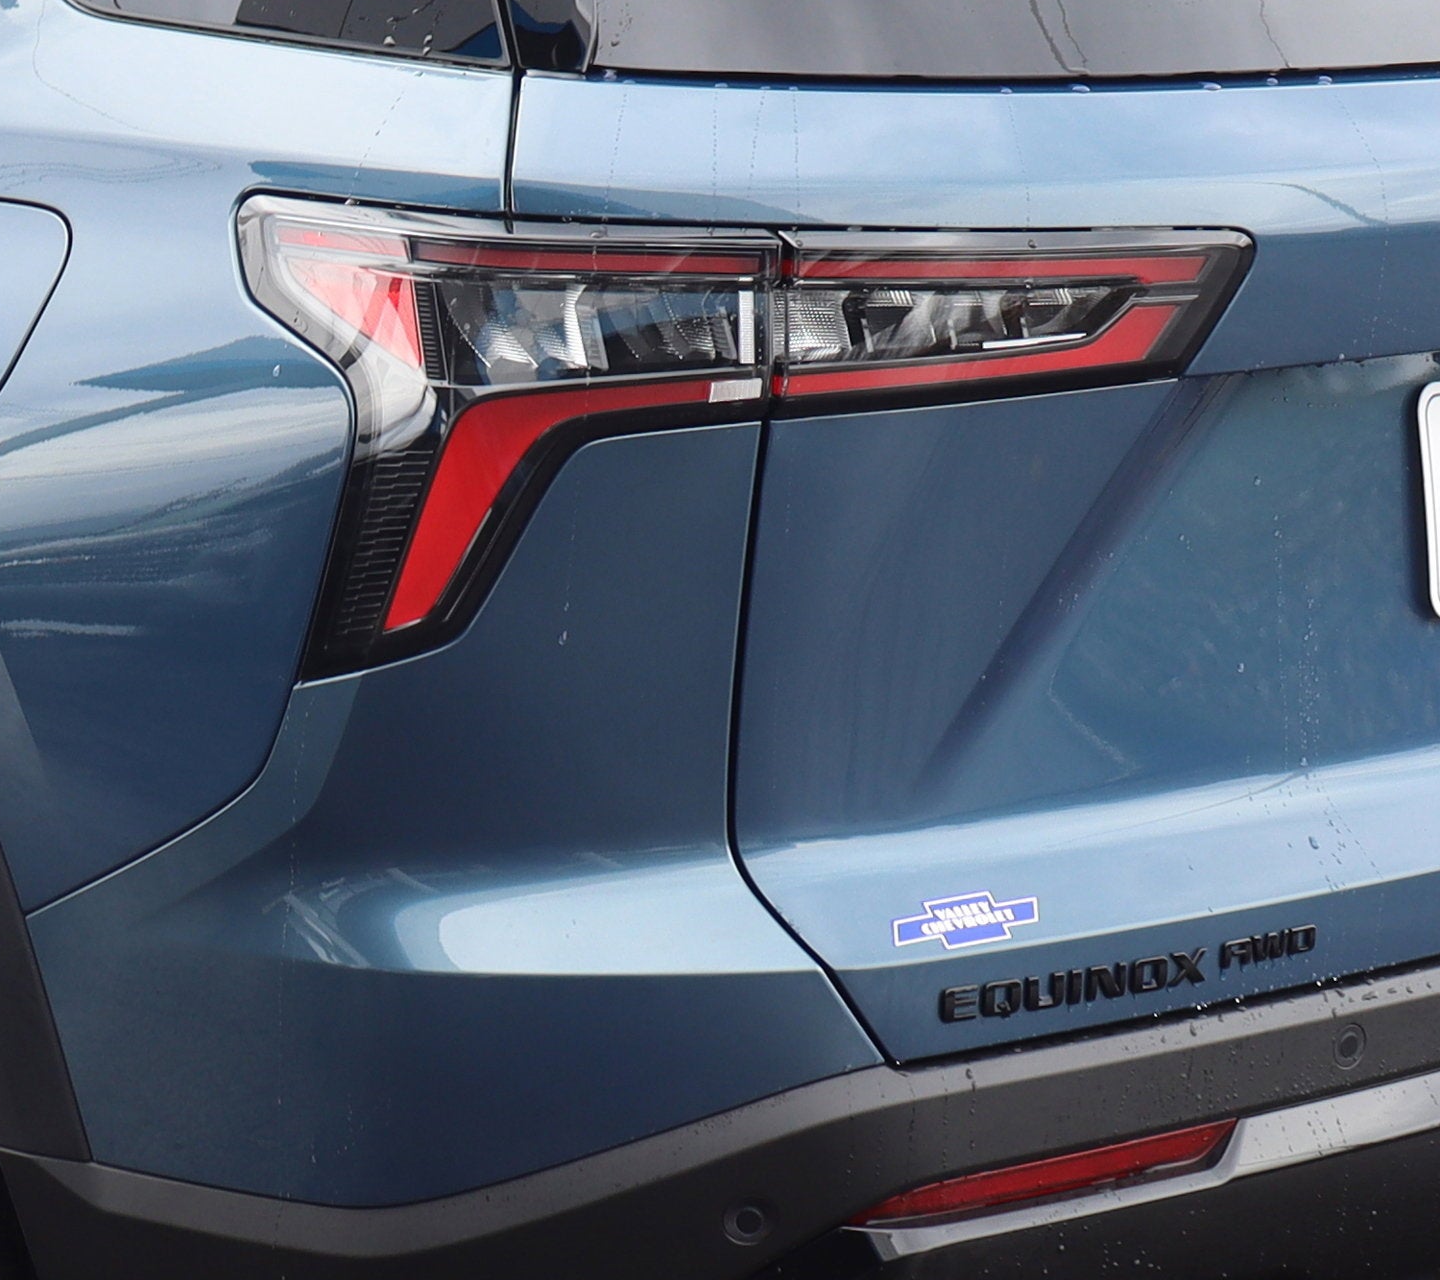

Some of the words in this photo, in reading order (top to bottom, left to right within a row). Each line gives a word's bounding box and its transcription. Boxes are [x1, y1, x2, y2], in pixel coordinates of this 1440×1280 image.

[921, 908, 1015, 935] CHEVROLET
[933, 901, 991, 921] VALLEY
[938, 948, 1208, 1024] EQUINOX
[1220, 924, 1317, 970] AWD
